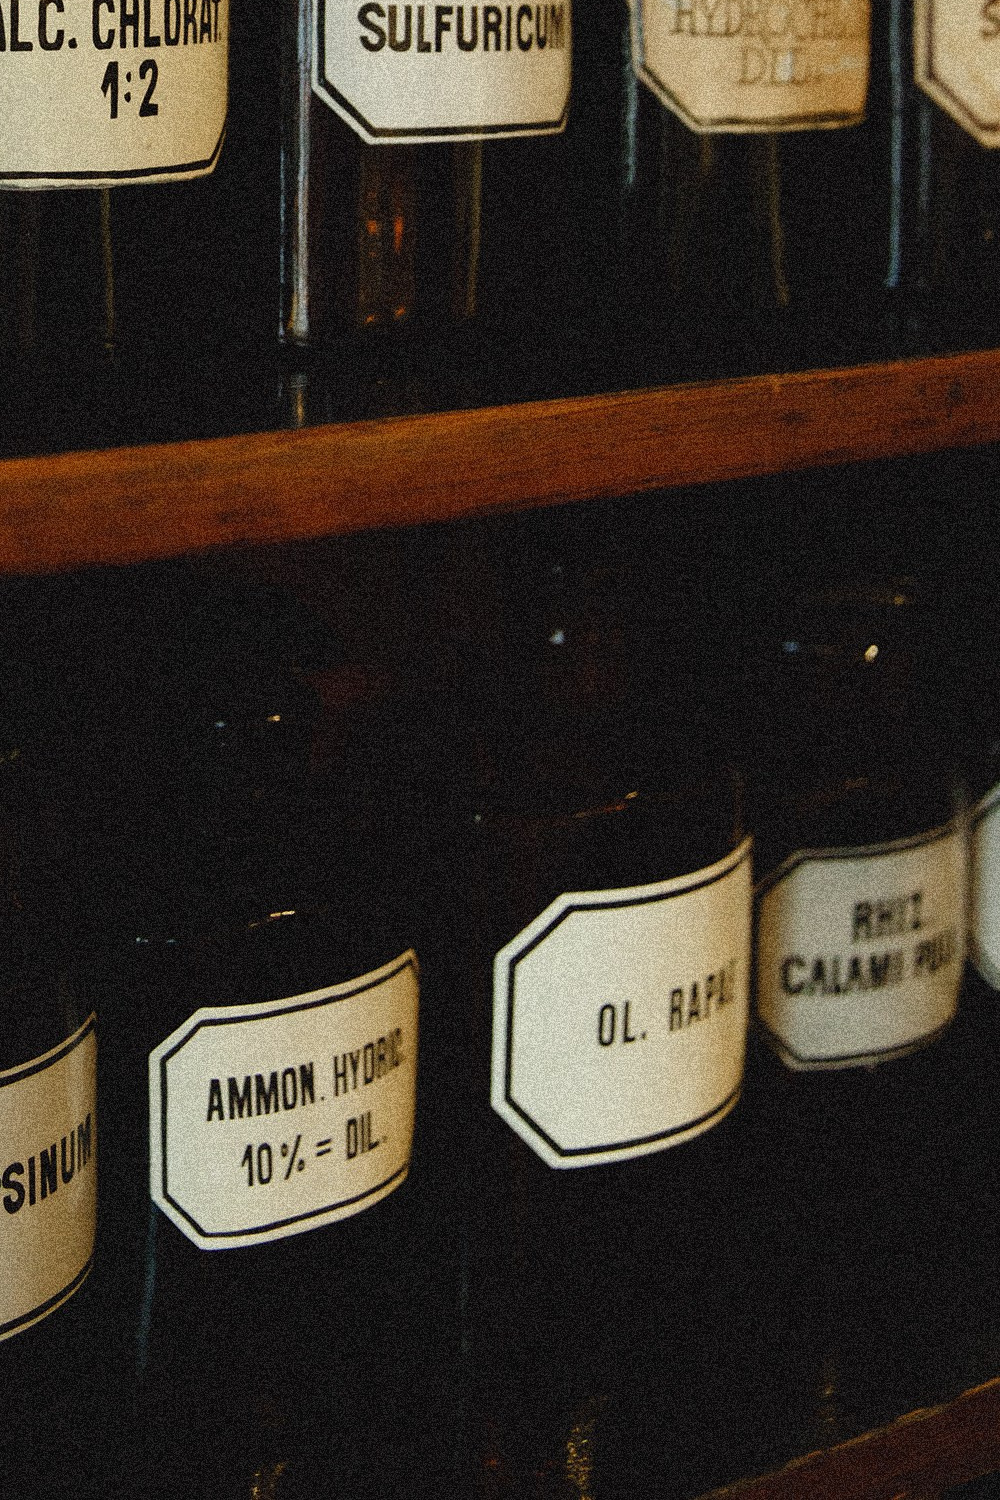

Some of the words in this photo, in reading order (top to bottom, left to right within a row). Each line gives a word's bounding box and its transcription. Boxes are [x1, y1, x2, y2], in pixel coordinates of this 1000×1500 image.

[100, 58, 159, 120] 1:2
[598, 1000, 647, 1047] OL.
[206, 1062, 325, 1122] AMMON.
